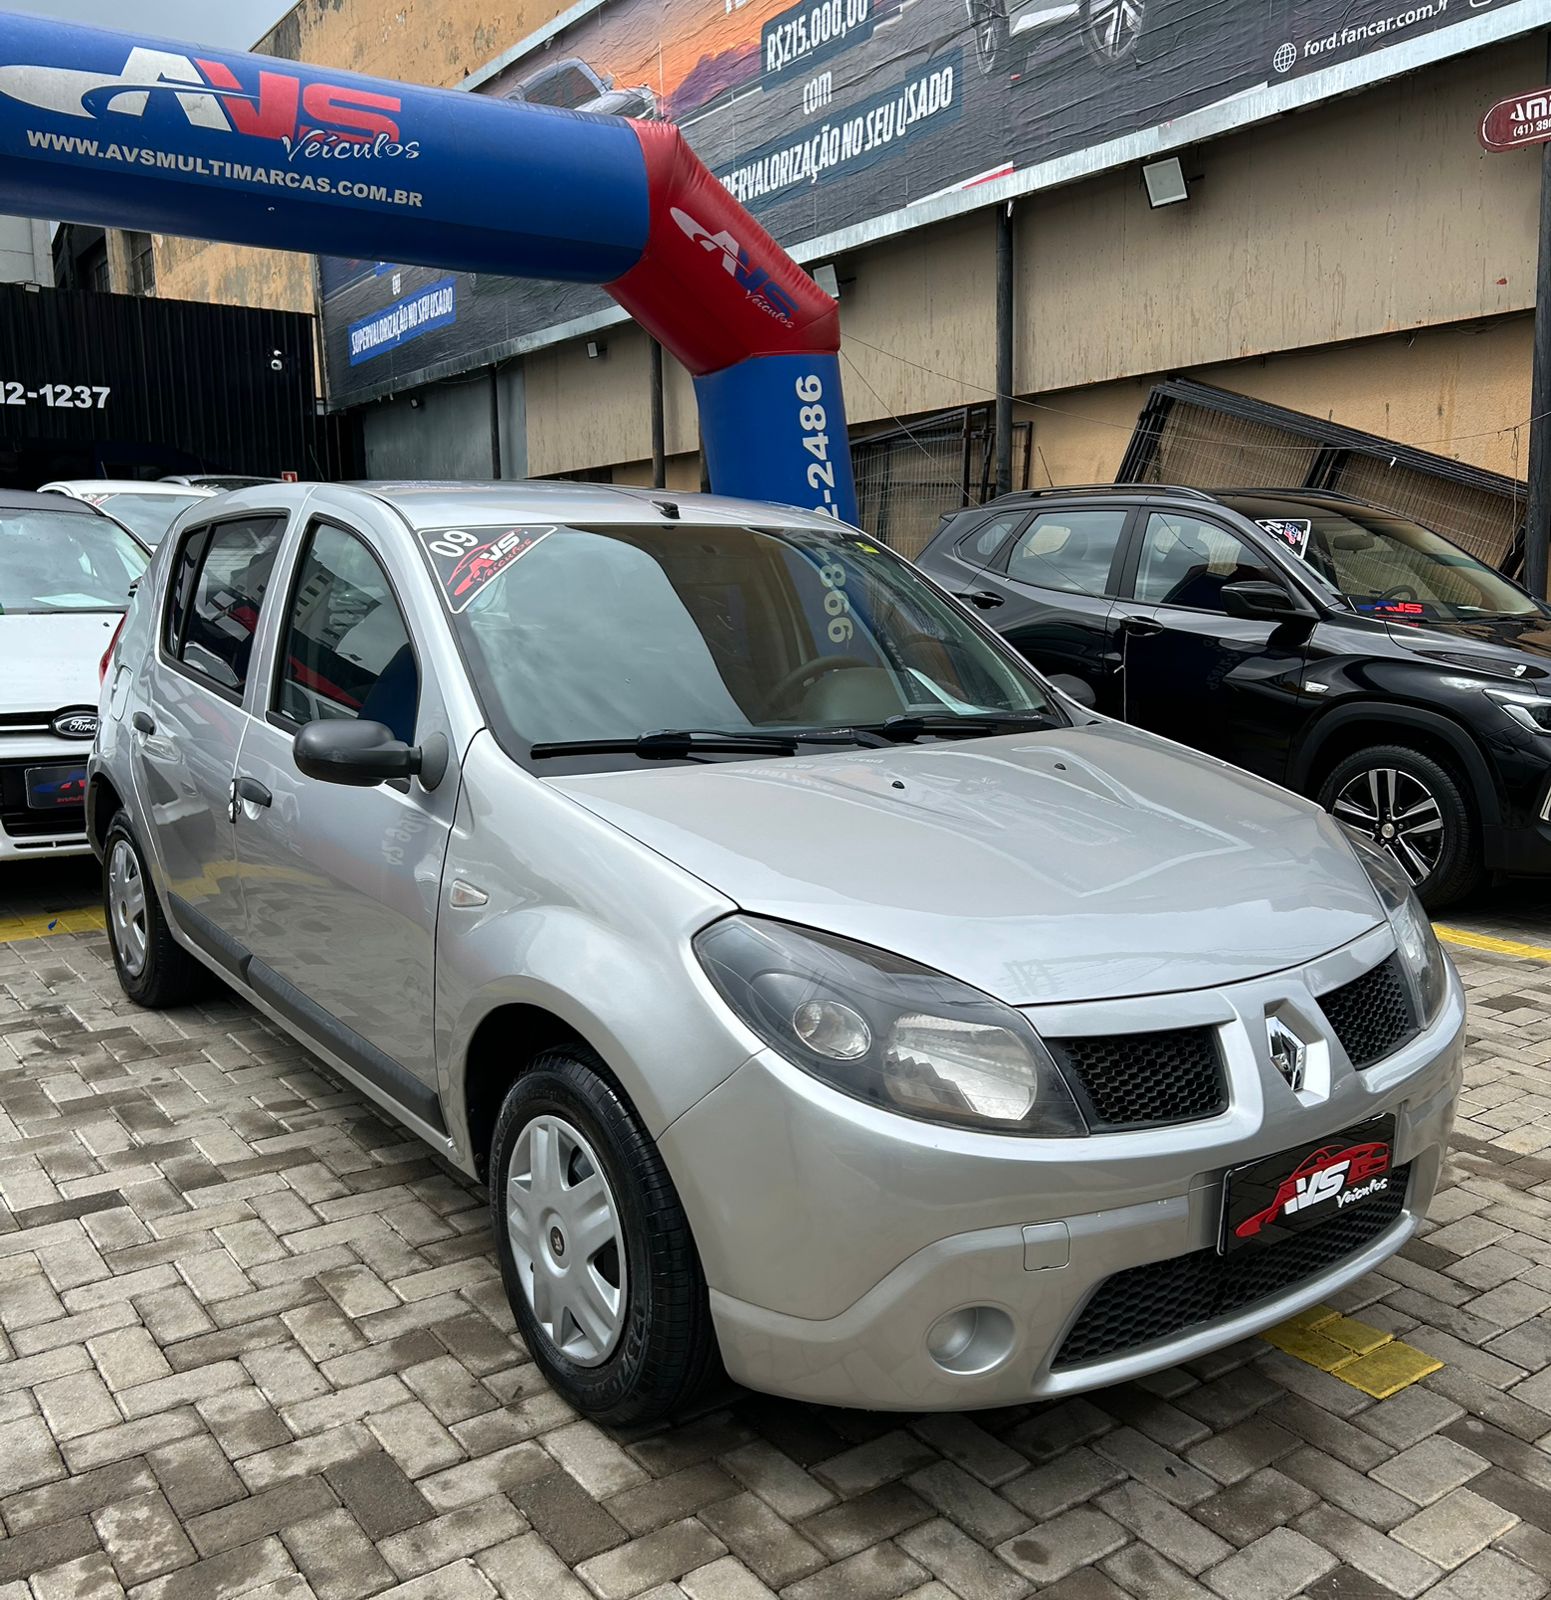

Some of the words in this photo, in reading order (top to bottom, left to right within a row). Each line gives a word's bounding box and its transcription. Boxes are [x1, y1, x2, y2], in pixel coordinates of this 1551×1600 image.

[766, 0, 868, 71] R$215.000,00
[88, 46, 401, 146] AVS
[1510, 97, 1551, 121] AM
[281, 129, 420, 162] Veículos
[719, 124, 839, 202] PERVALORIZAÇÃO
[841, 117, 863, 161] NO
[865, 101, 896, 151] SEU
[896, 66, 953, 136] USADO
[1513, 122, 1533, 137] (41)
[1536, 118, 1551, 131] 39
[27, 129, 422, 207] WWW.AVSMULTIMARCAS.COM.BR
[685, 220, 799, 318] AVS
[351, 305, 409, 355] SUPERVALORIZAÇÃO
[408, 301, 418, 329] NO
[417, 295, 430, 324] SEU
[430, 286, 453, 318] USADO
[745, 289, 795, 329] Veículos
[429, 530, 479, 558] 09
[1336, 1178, 1388, 1208] Veículos
